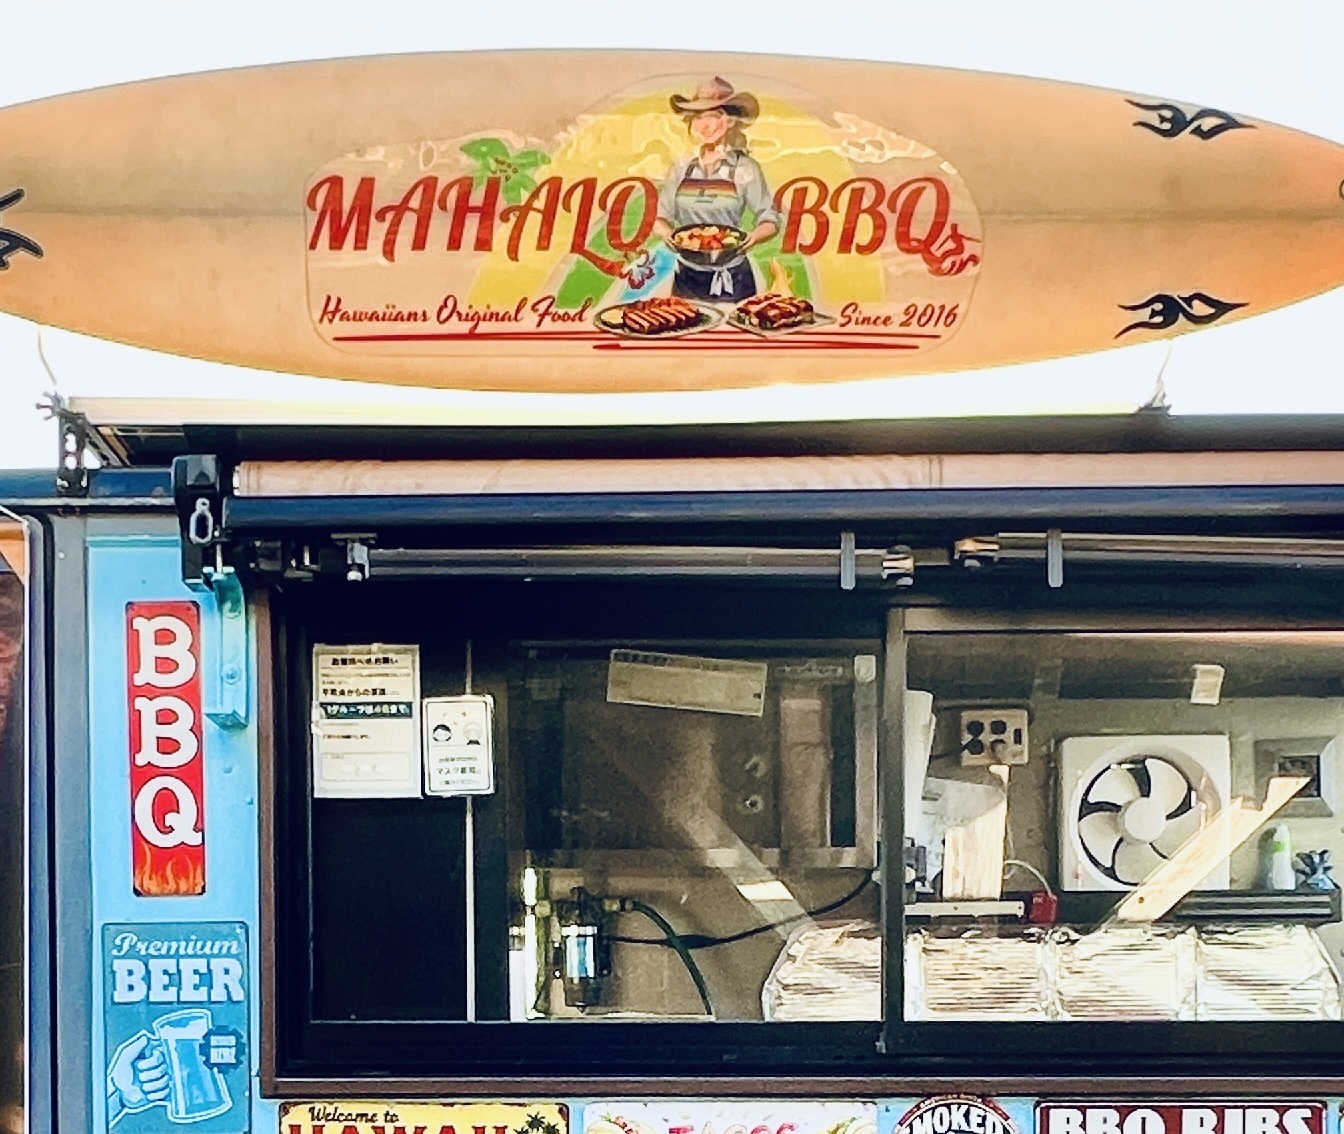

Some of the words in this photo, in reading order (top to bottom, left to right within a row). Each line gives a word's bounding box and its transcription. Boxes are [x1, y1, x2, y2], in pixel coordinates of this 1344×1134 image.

[306, 174, 660, 279] MAHALO
[773, 175, 974, 276] BBQ
[319, 294, 430, 324] Hawaiians
[436, 294, 524, 333] Original
[531, 296, 596, 328] Food
[838, 302, 894, 328] Since
[898, 302, 958, 328] 2016
[132, 614, 203, 848] BBQ
[109, 931, 239, 956] Premium
[112, 958, 245, 1004] BEER
[308, 1106, 378, 1123] Welcome
[384, 1110, 399, 1123] to
